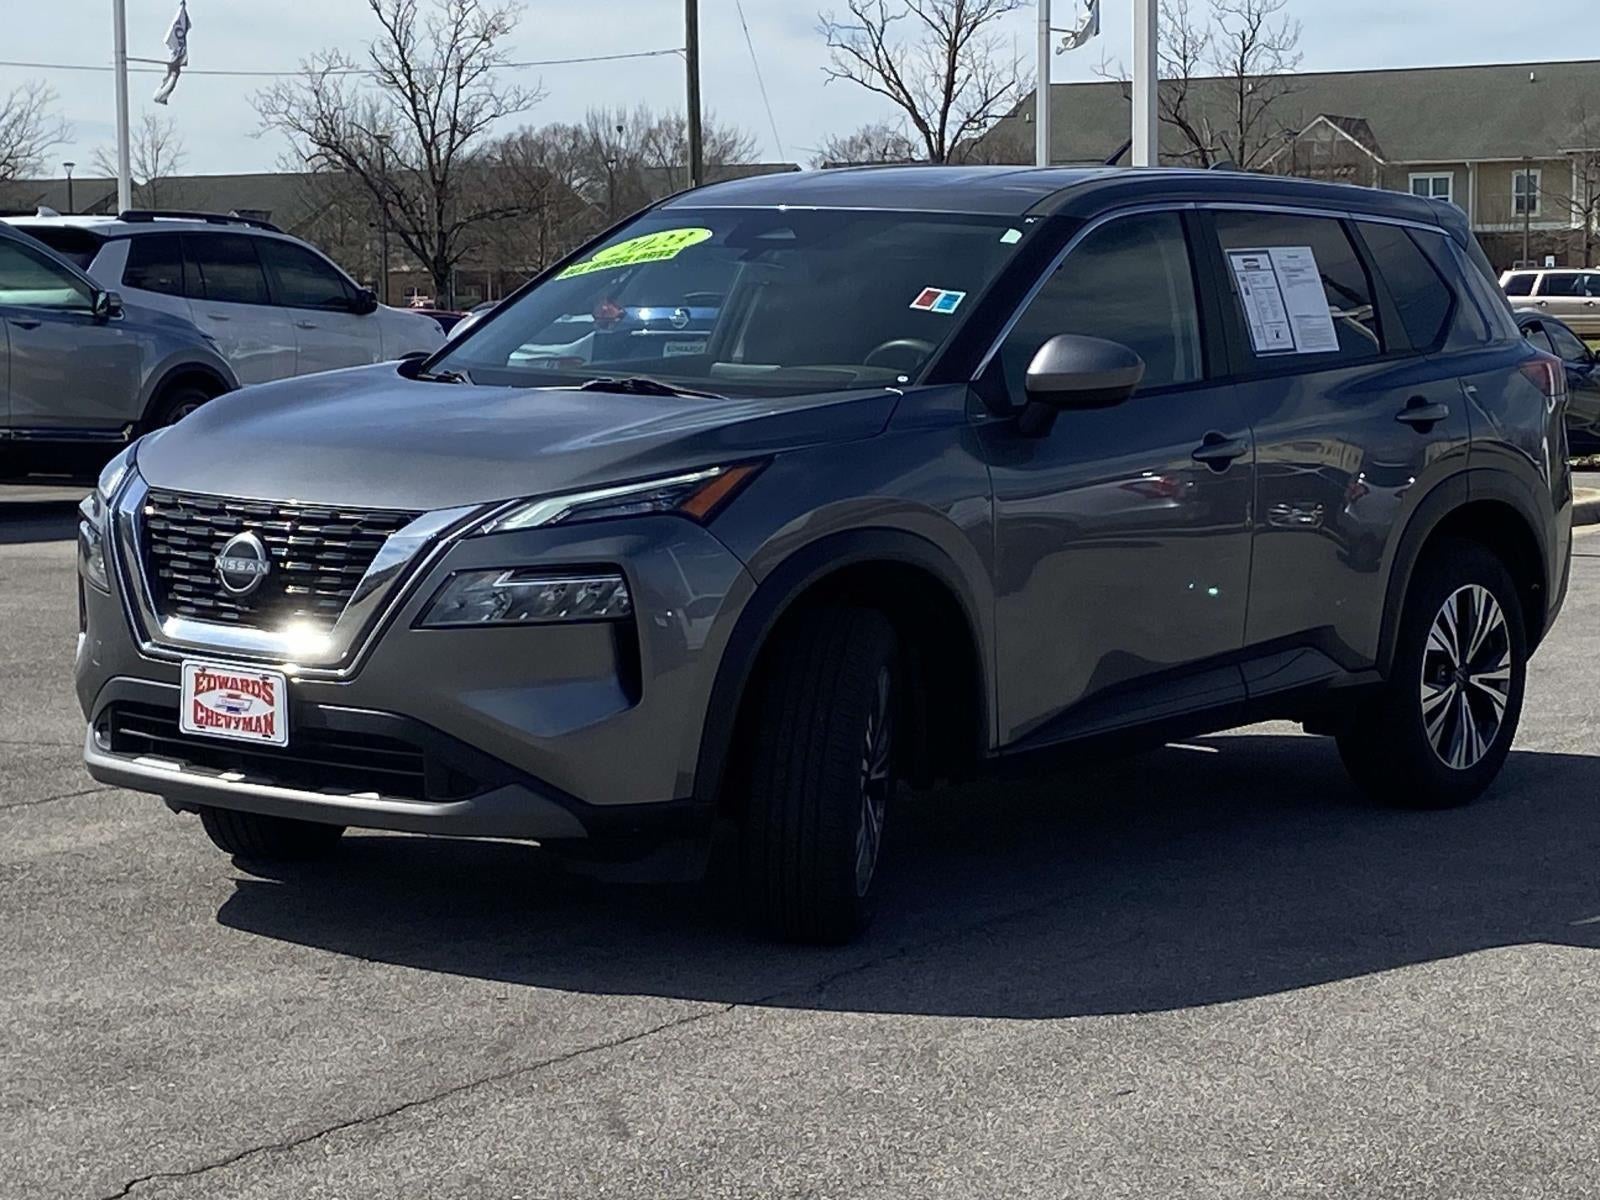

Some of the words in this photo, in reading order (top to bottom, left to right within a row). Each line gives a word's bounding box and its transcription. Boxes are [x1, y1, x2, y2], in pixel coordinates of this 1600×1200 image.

[215, 557, 268, 574] NISSAN
[194, 672, 274, 707] EDWARDS
[194, 698, 275, 735] CHEVYMAN
